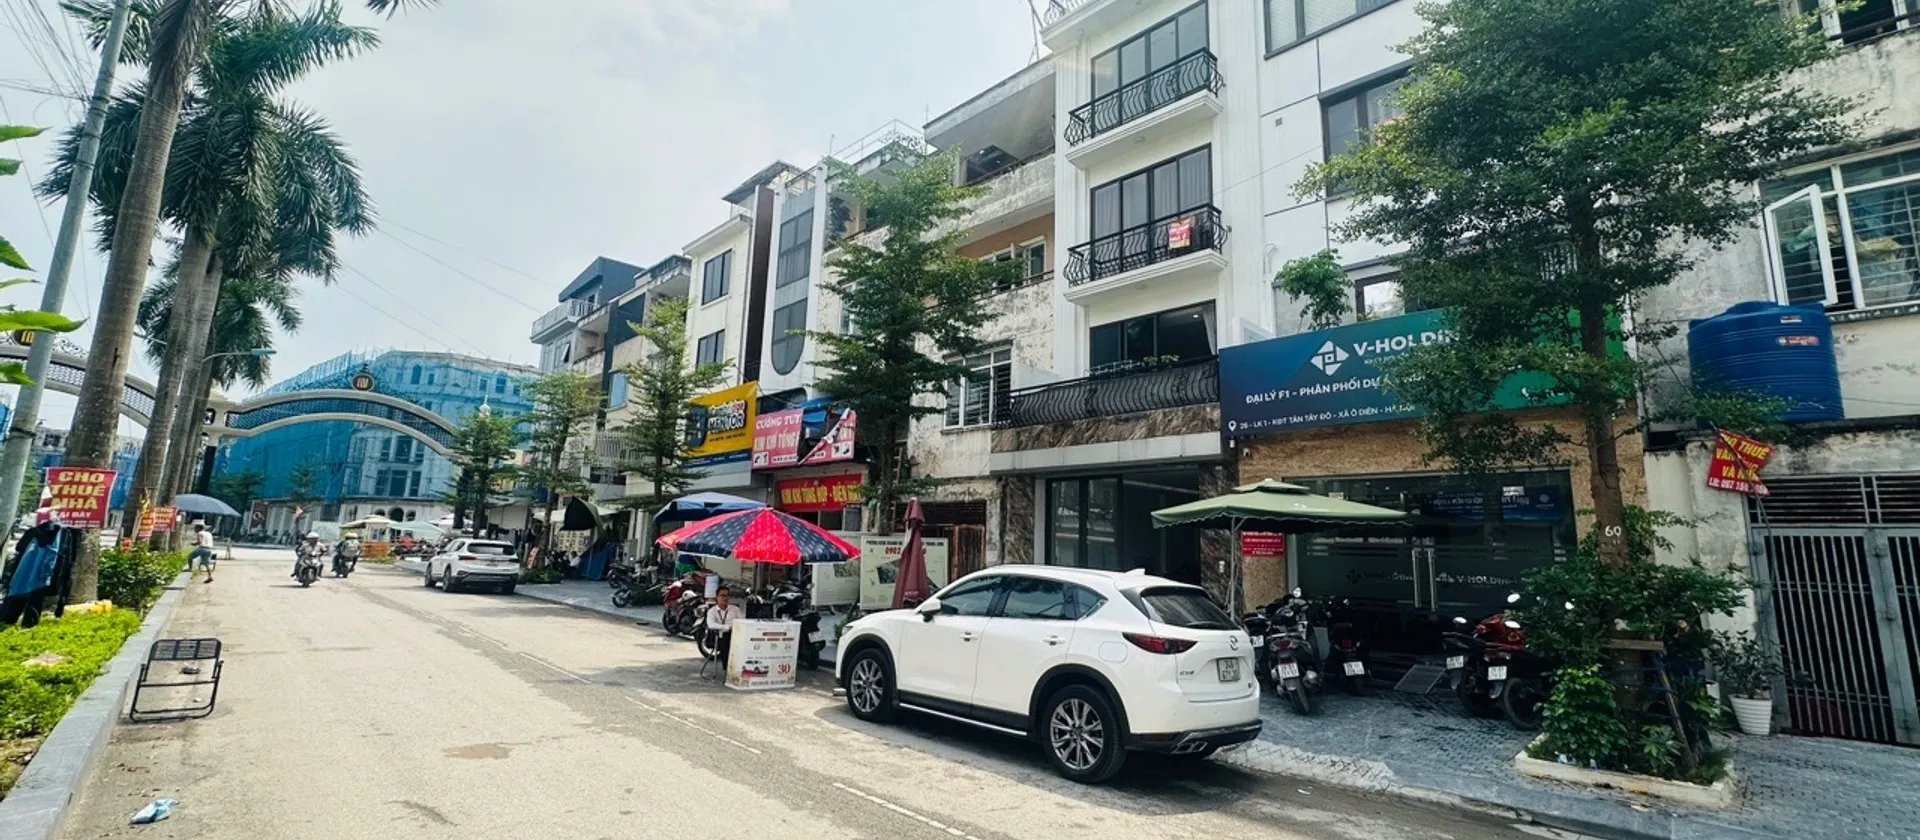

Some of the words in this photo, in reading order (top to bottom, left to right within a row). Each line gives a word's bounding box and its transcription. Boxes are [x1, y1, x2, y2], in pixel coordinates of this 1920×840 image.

[1246, 394, 1263, 405] ĐẠI
[1264, 389, 1277, 402] LÝ
[1278, 390, 1290, 400] F1
[1299, 383, 1331, 397] PHÂN
[1332, 376, 1361, 392] PHỐI
[58, 471, 105, 483] CHO
[50, 482, 106, 496] THUÊ
[51, 496, 98, 510] NHÀ
